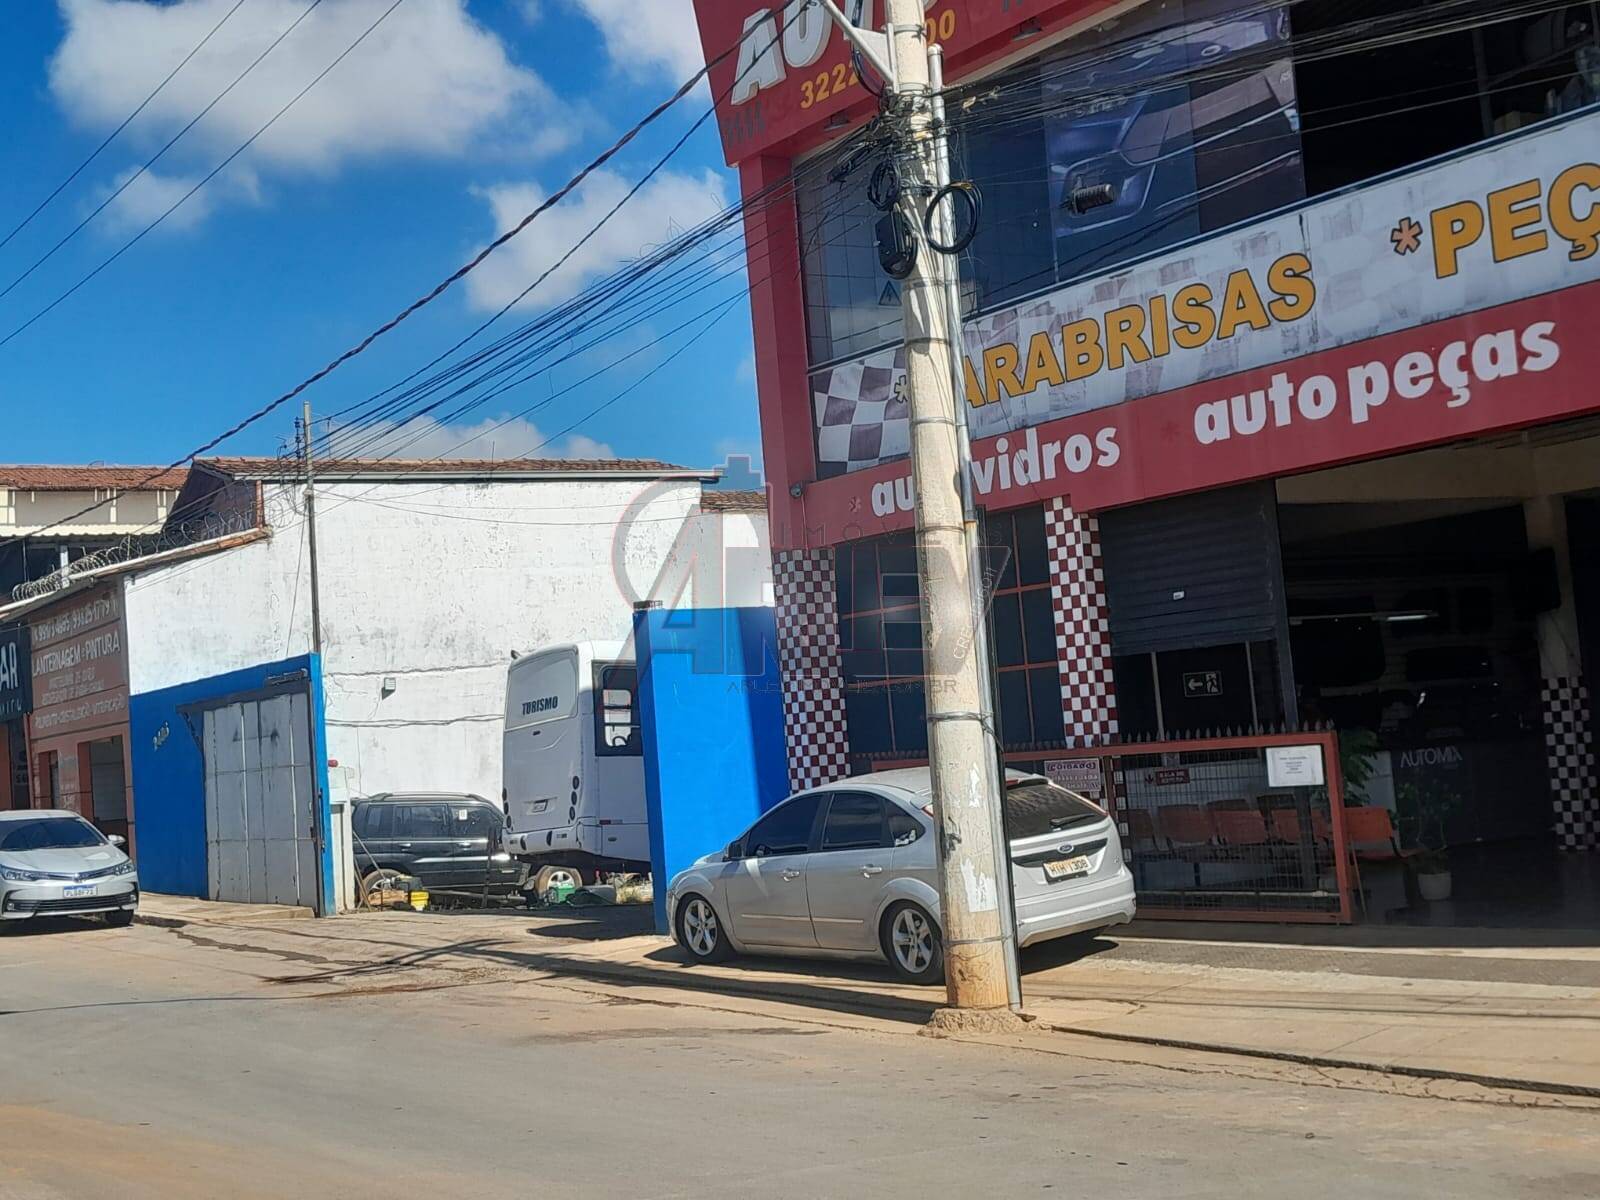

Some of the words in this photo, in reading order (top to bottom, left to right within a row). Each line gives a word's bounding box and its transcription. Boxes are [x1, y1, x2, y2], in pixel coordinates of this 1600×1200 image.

[731, 0, 874, 105] AU
[964, 252, 1316, 409] ARABRISAS
[1194, 371, 1338, 445] auto
[1347, 320, 1561, 425] peças
[871, 475, 915, 517] au
[971, 426, 1121, 495] vidros
[522, 695, 559, 716] TURISMO
